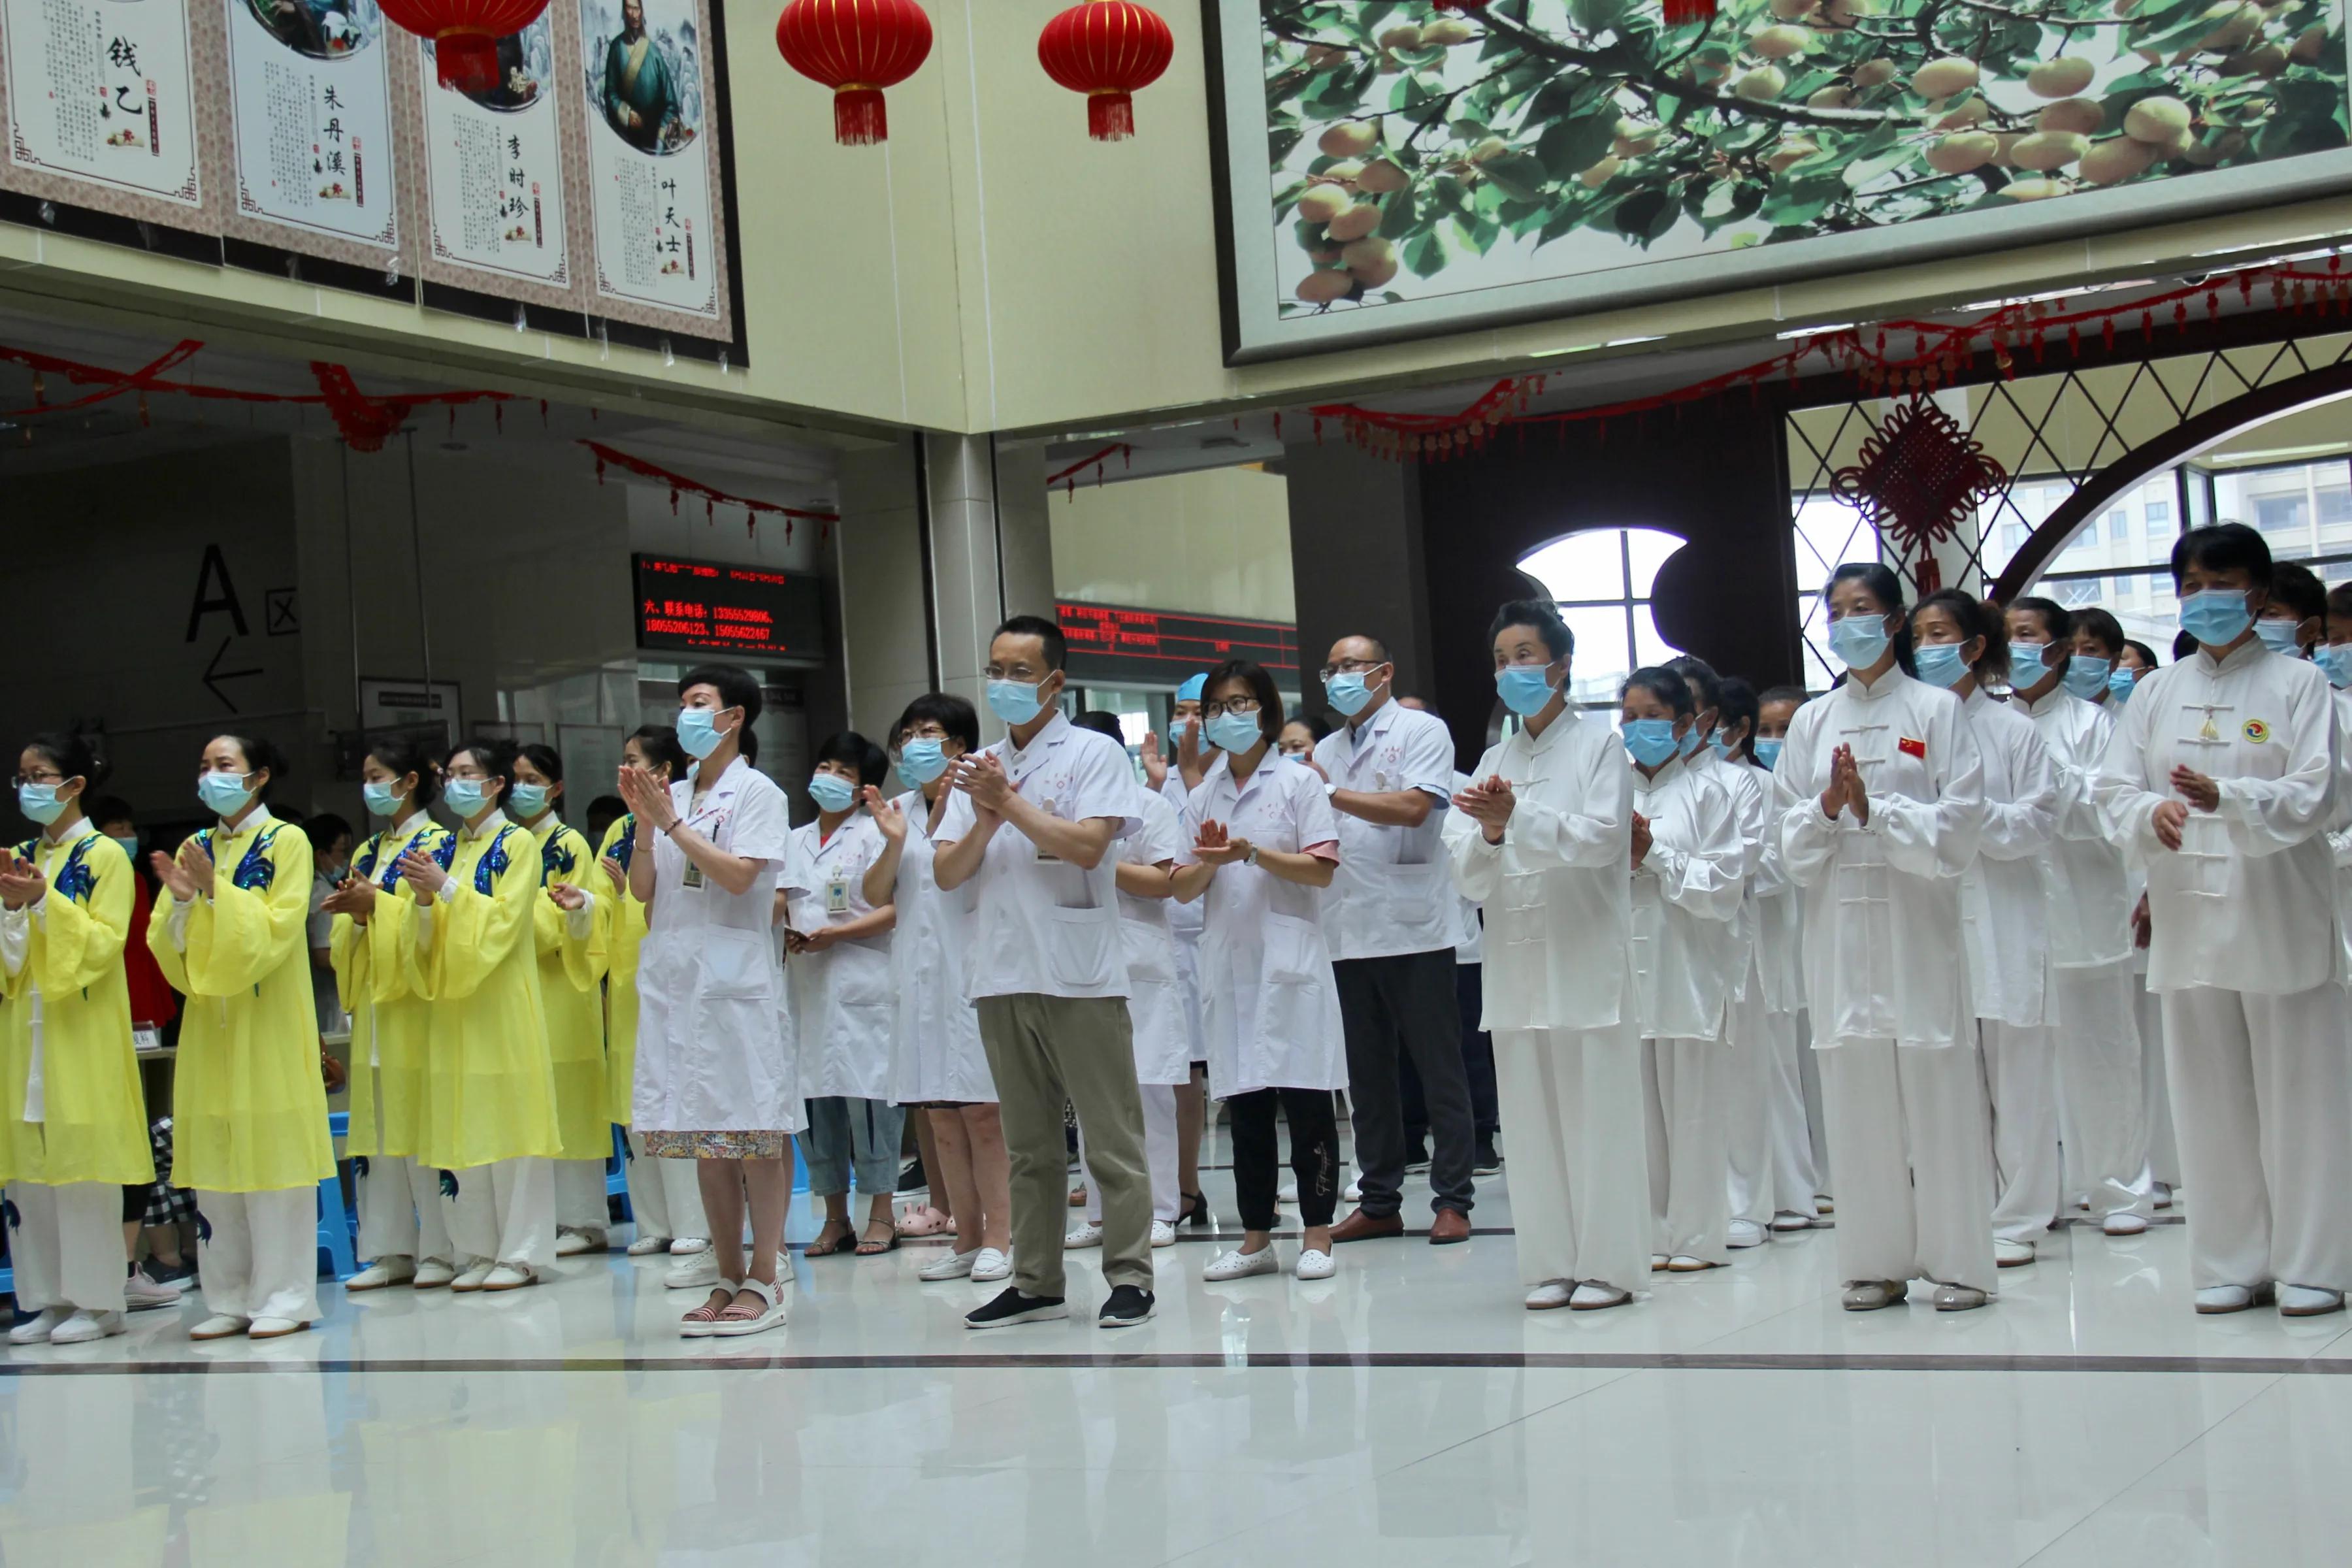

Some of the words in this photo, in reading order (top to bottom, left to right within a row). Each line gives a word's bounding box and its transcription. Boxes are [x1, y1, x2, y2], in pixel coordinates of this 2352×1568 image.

[106, 36, 142, 115] 钱乙
[323, 85, 346, 176] 朱丹溪
[507, 134, 530, 219] 李时珍
[661, 178, 681, 253] 叶天士
